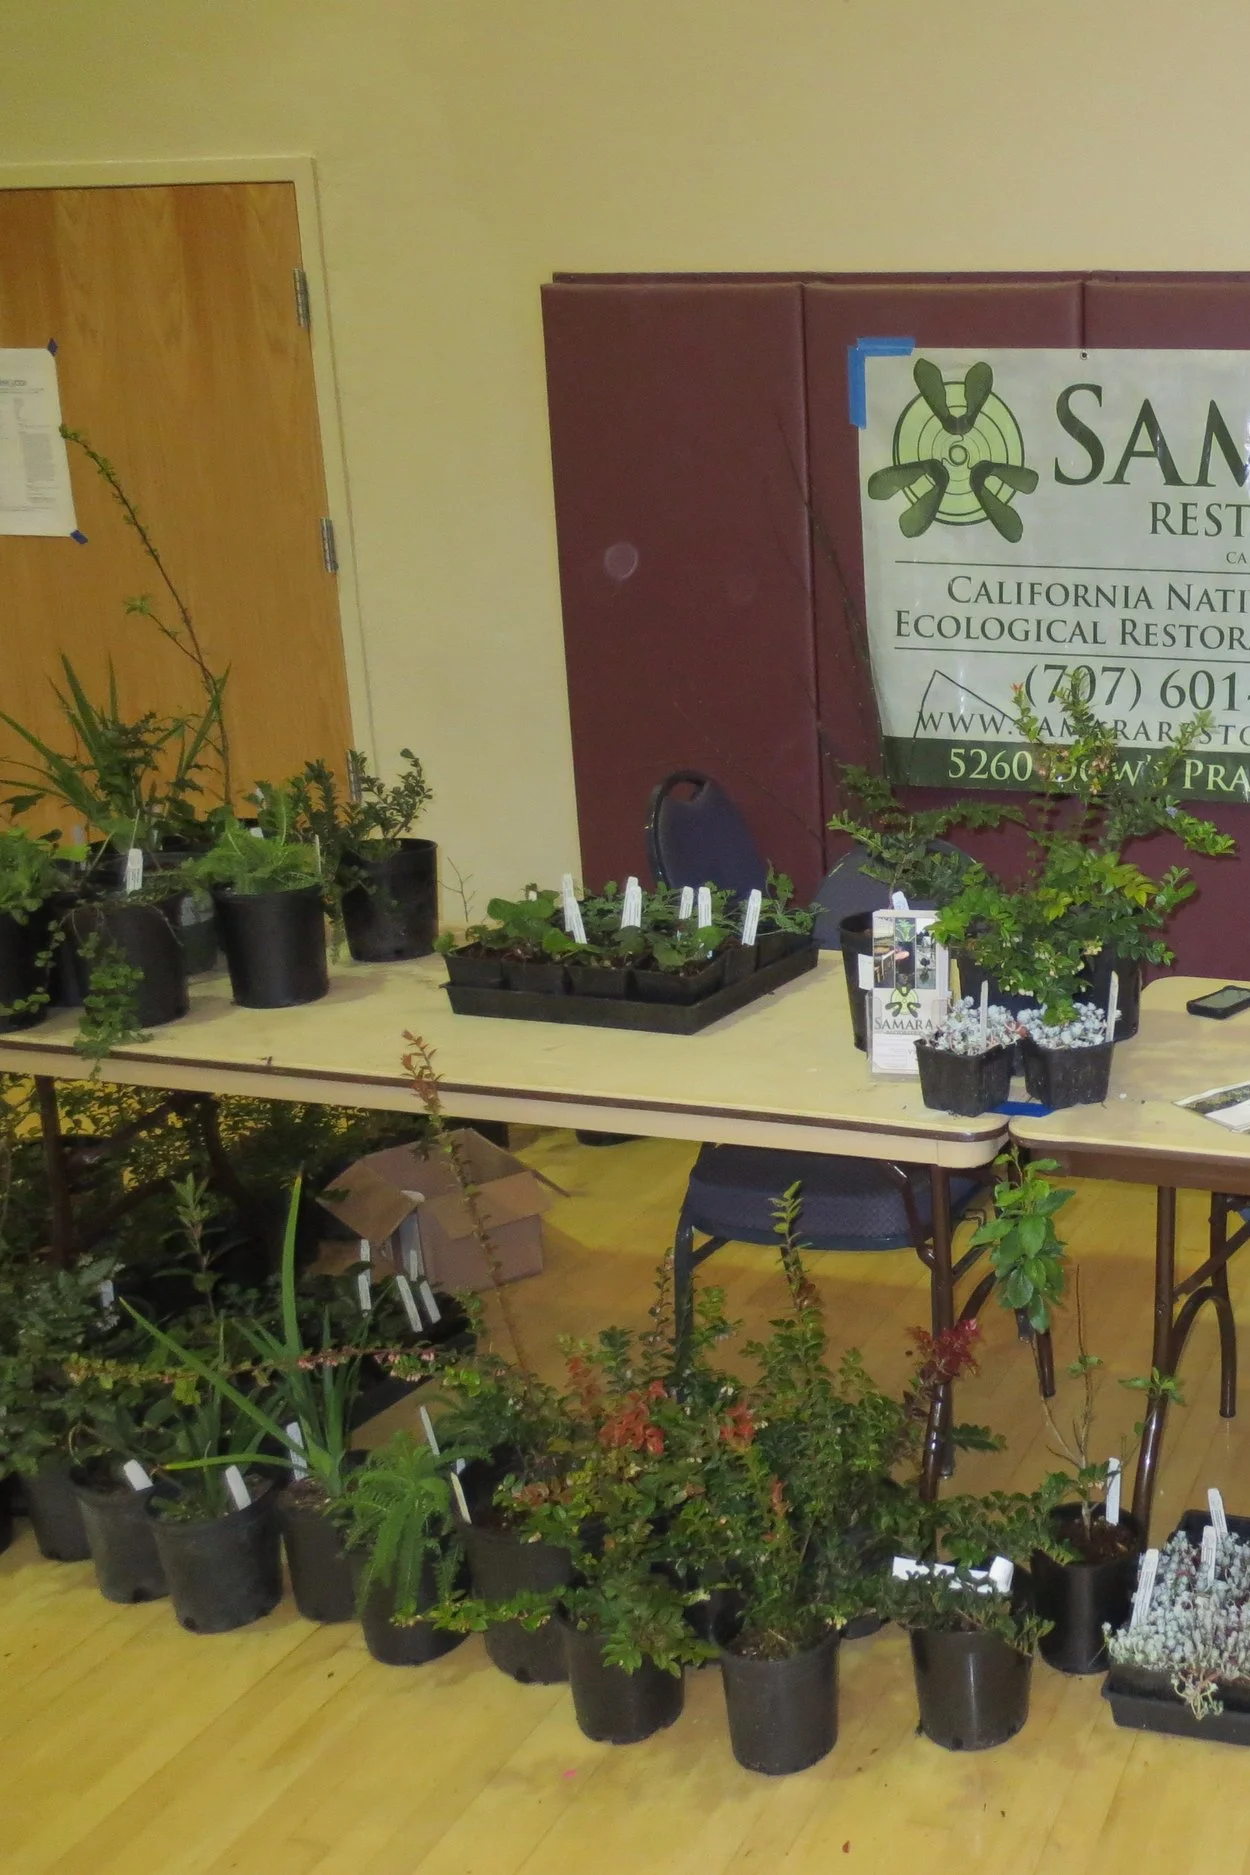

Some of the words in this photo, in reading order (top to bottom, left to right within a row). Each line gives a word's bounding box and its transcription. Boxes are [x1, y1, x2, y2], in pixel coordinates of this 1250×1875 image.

[1226, 551, 1247, 565] CA
[947, 575, 1154, 610] CALIFORNIA
[895, 609, 1106, 645] ECOLOGICAL
[1025, 664, 1142, 712] (707)
[948, 748, 1033, 782] 5260
